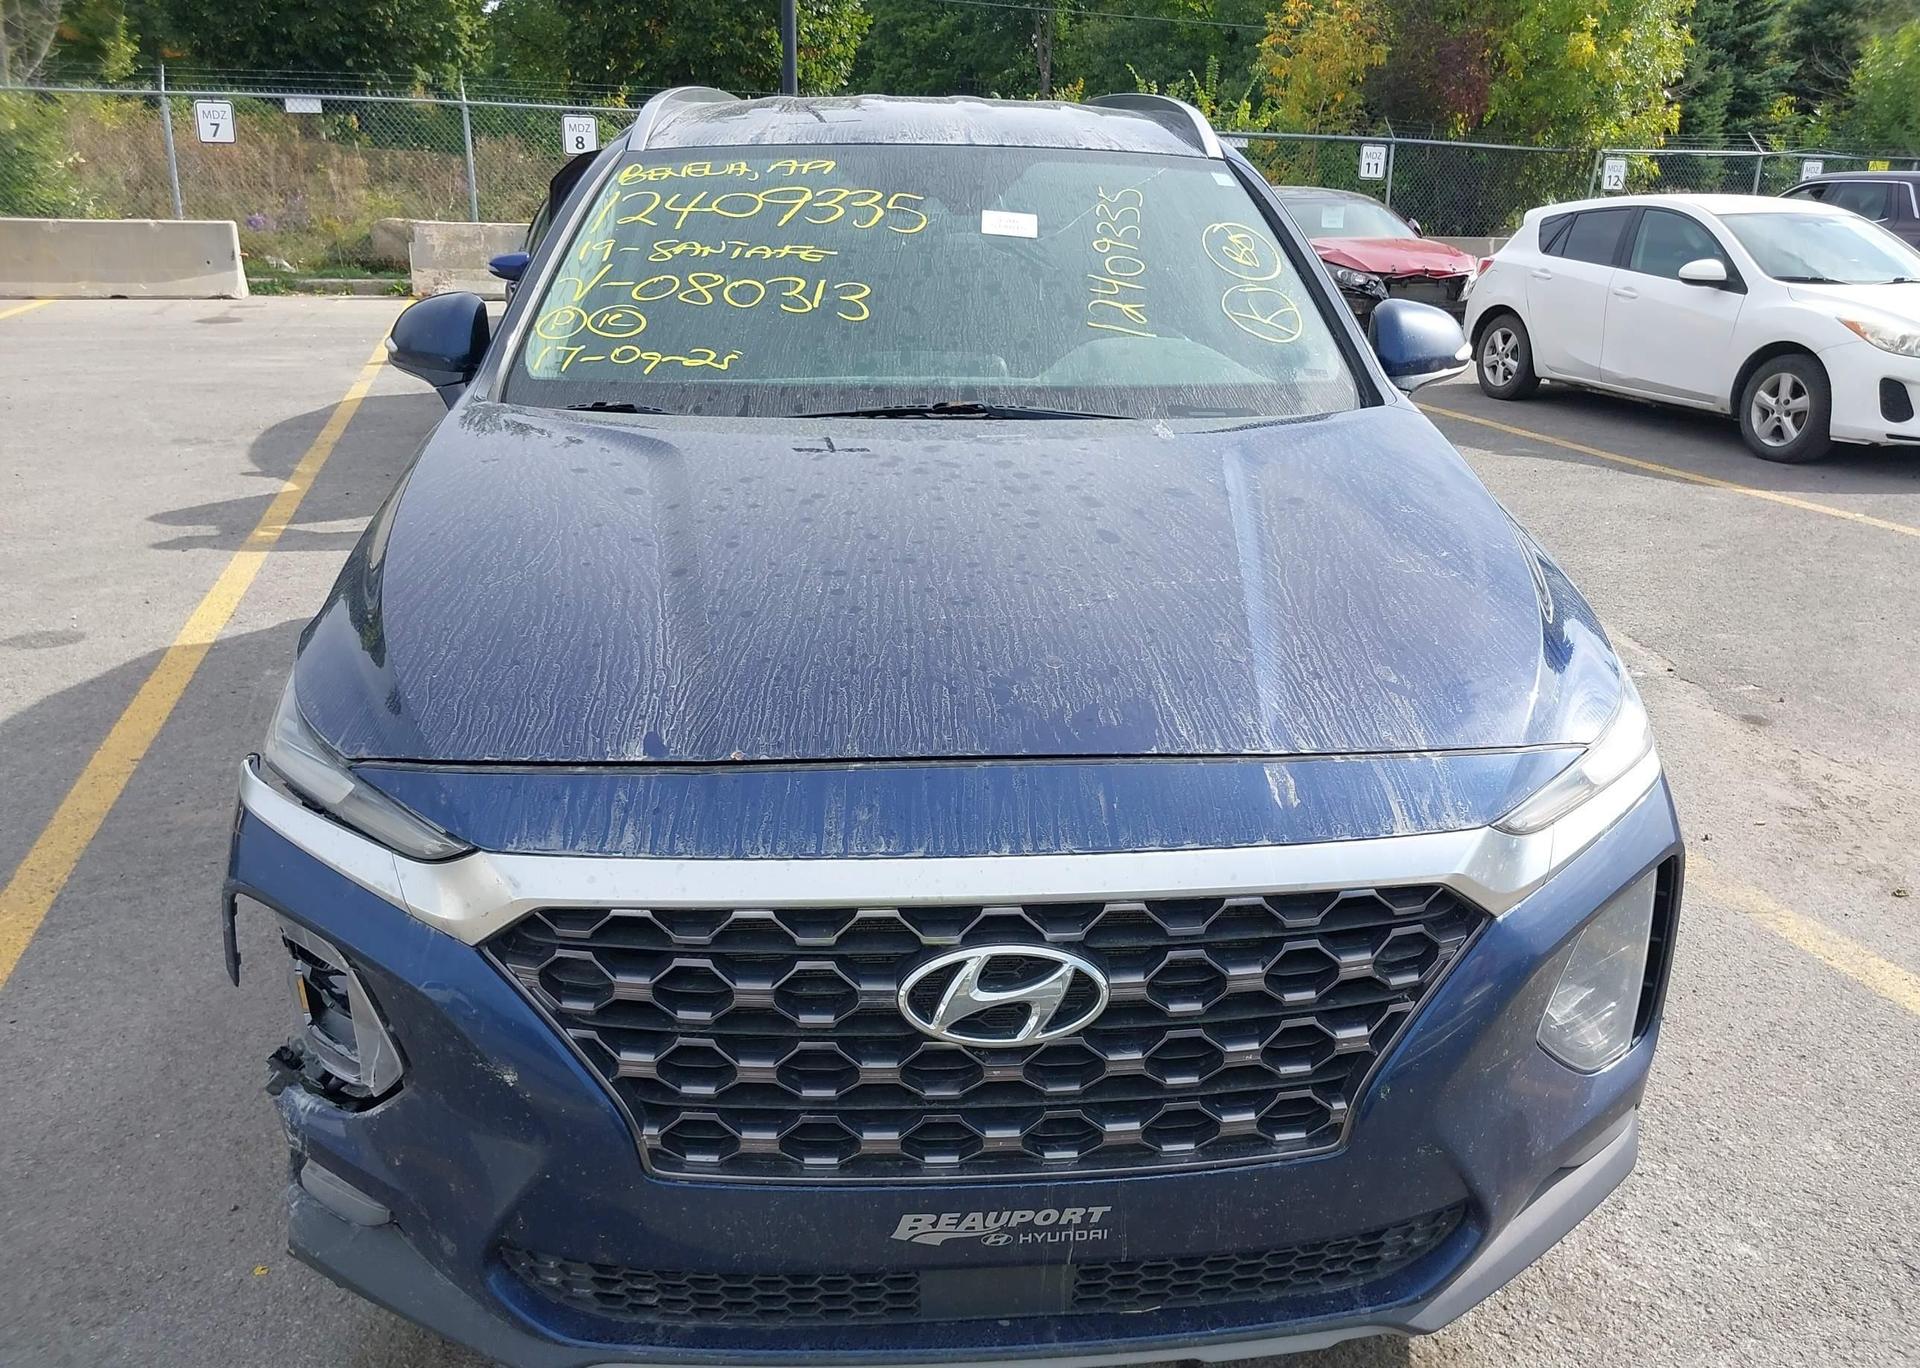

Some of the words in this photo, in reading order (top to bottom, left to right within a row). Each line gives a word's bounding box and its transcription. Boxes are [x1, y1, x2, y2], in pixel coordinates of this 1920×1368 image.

[202, 110, 227, 120] MDZ
[209, 122, 220, 138] 7
[568, 123, 592, 133] MDZ
[575, 135, 585, 150] 8
[1364, 151, 1382, 160] MDZ
[1365, 162, 1379, 174] 11
[1607, 174, 1620, 187] 12
[590, 186, 928, 233] 12409335
[1087, 185, 1158, 339] 12409335
[891, 1206, 1112, 1242] BEAUPORT
[1019, 1229, 1108, 1244] HYUNDAI
